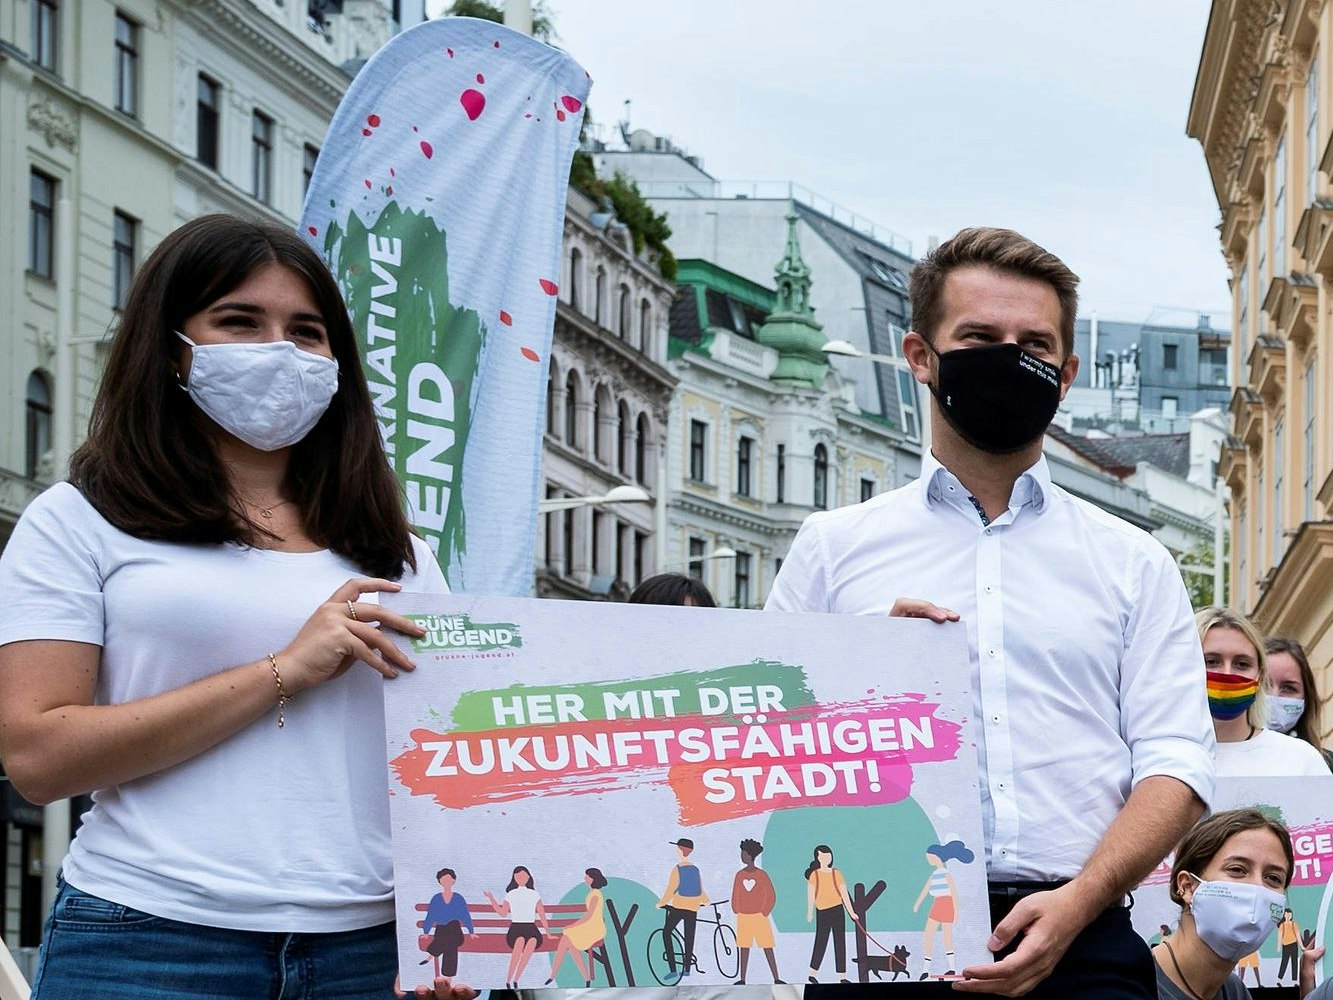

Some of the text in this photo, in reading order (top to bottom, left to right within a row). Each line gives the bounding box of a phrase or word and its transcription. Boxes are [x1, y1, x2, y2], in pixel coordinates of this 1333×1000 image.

[1019, 360, 1036, 373] under
[1036, 370, 1047, 380] this
[1024, 355, 1044, 370] warmly
[406, 362, 455, 556] END
[414, 615, 465, 632] RÜNE
[417, 629, 513, 647] JUGEND
[492, 684, 787, 727] HER MIT DER
[421, 714, 935, 778] ZUKUNFTSFÄHIGEN
[702, 760, 883, 804] STADT!
